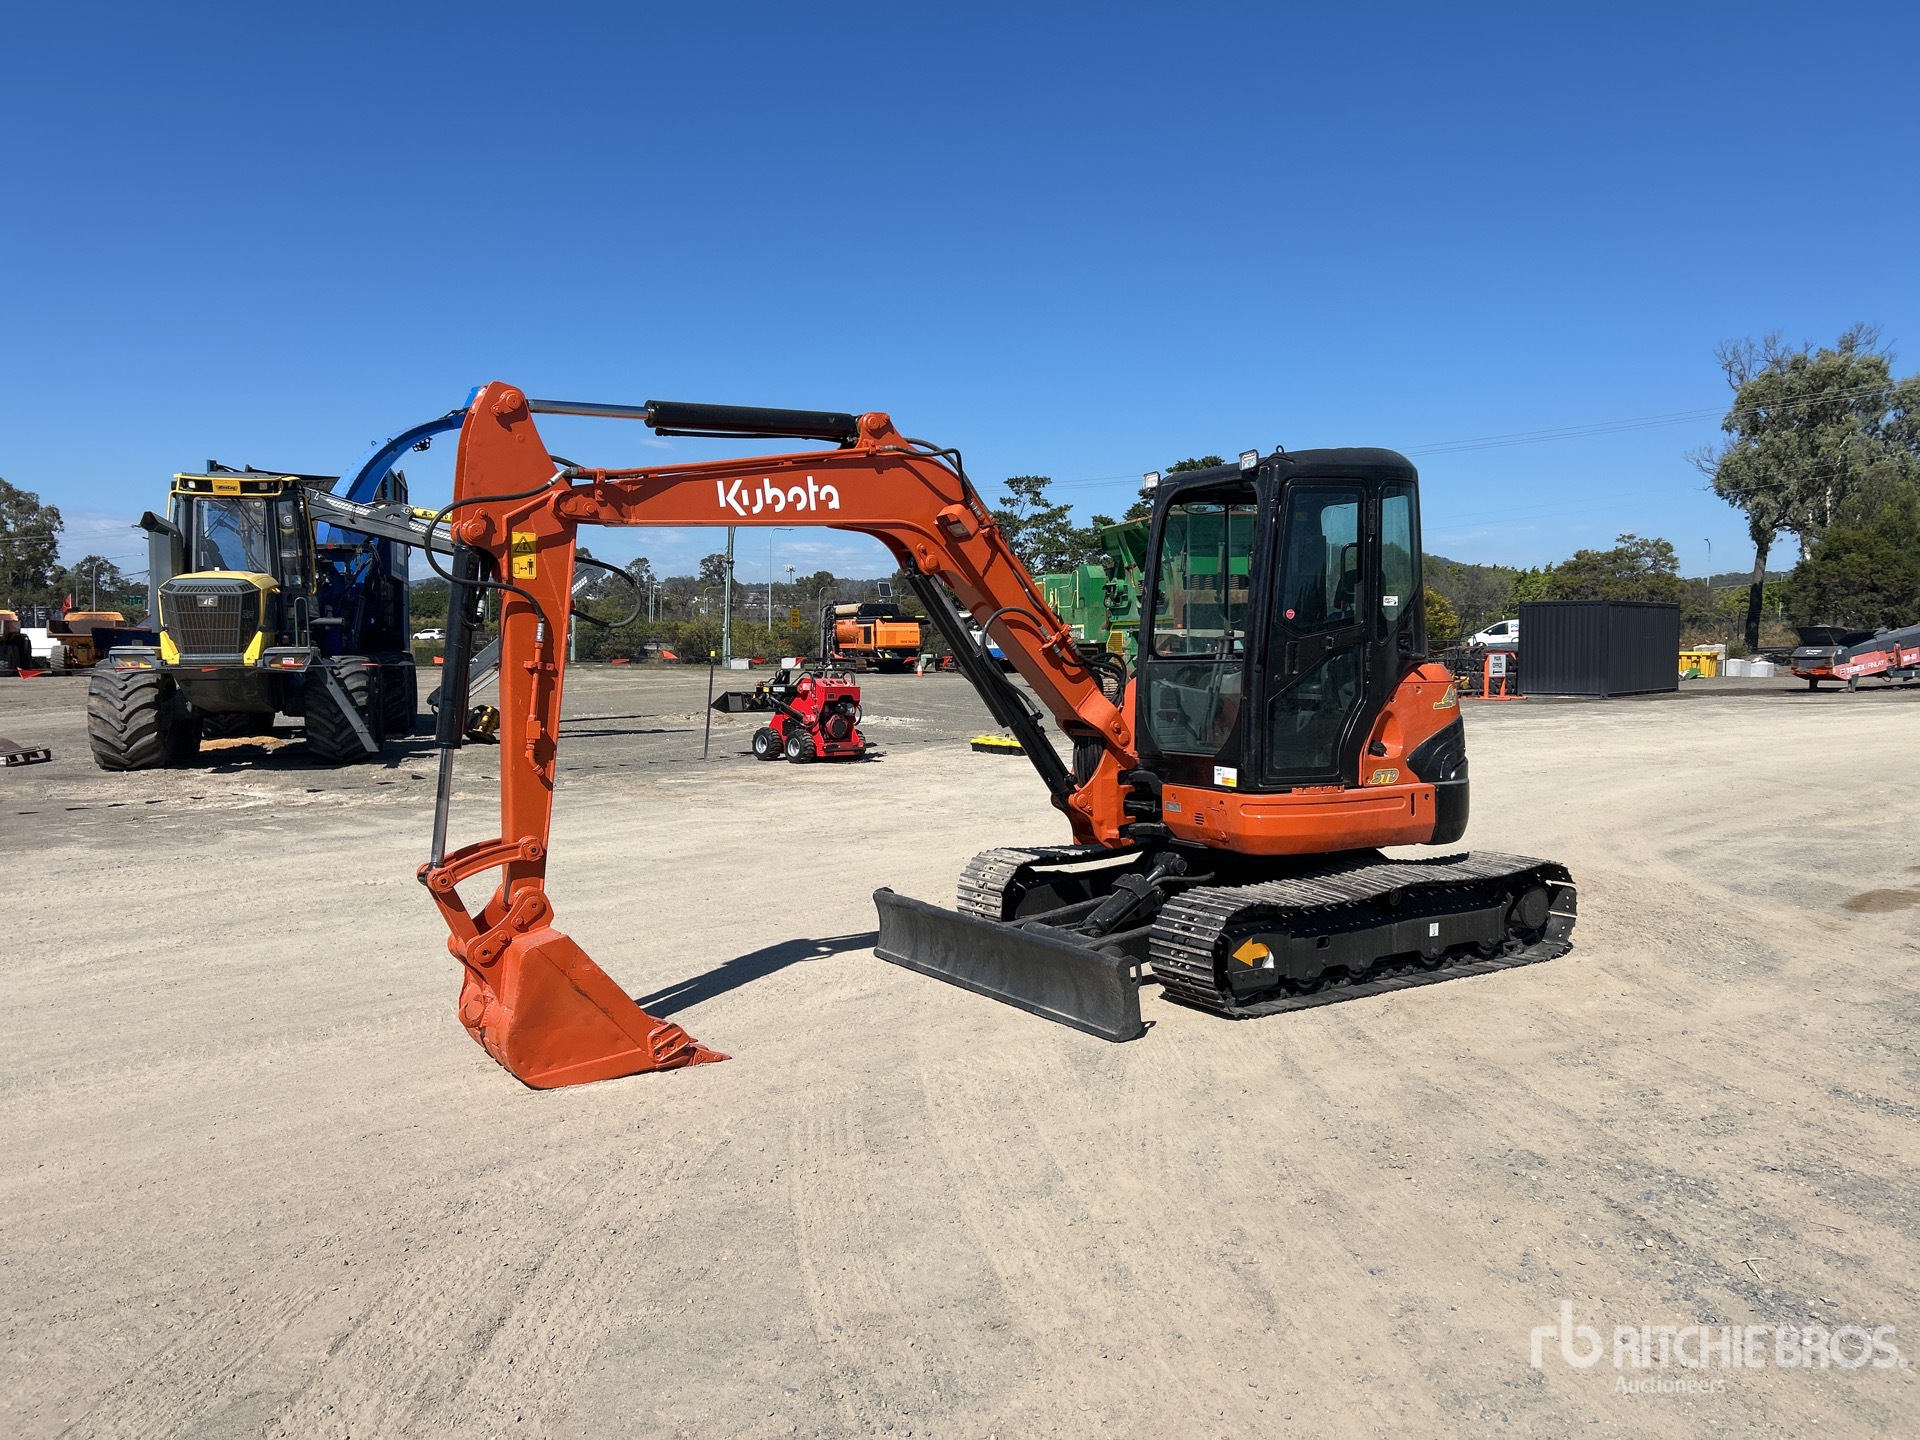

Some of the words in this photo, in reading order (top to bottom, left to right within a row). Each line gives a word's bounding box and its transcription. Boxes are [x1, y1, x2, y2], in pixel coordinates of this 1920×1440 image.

[716, 475, 840, 517] Kubota
[1846, 664, 1866, 674] TEREX
[1867, 659, 1885, 669] FINLAY
